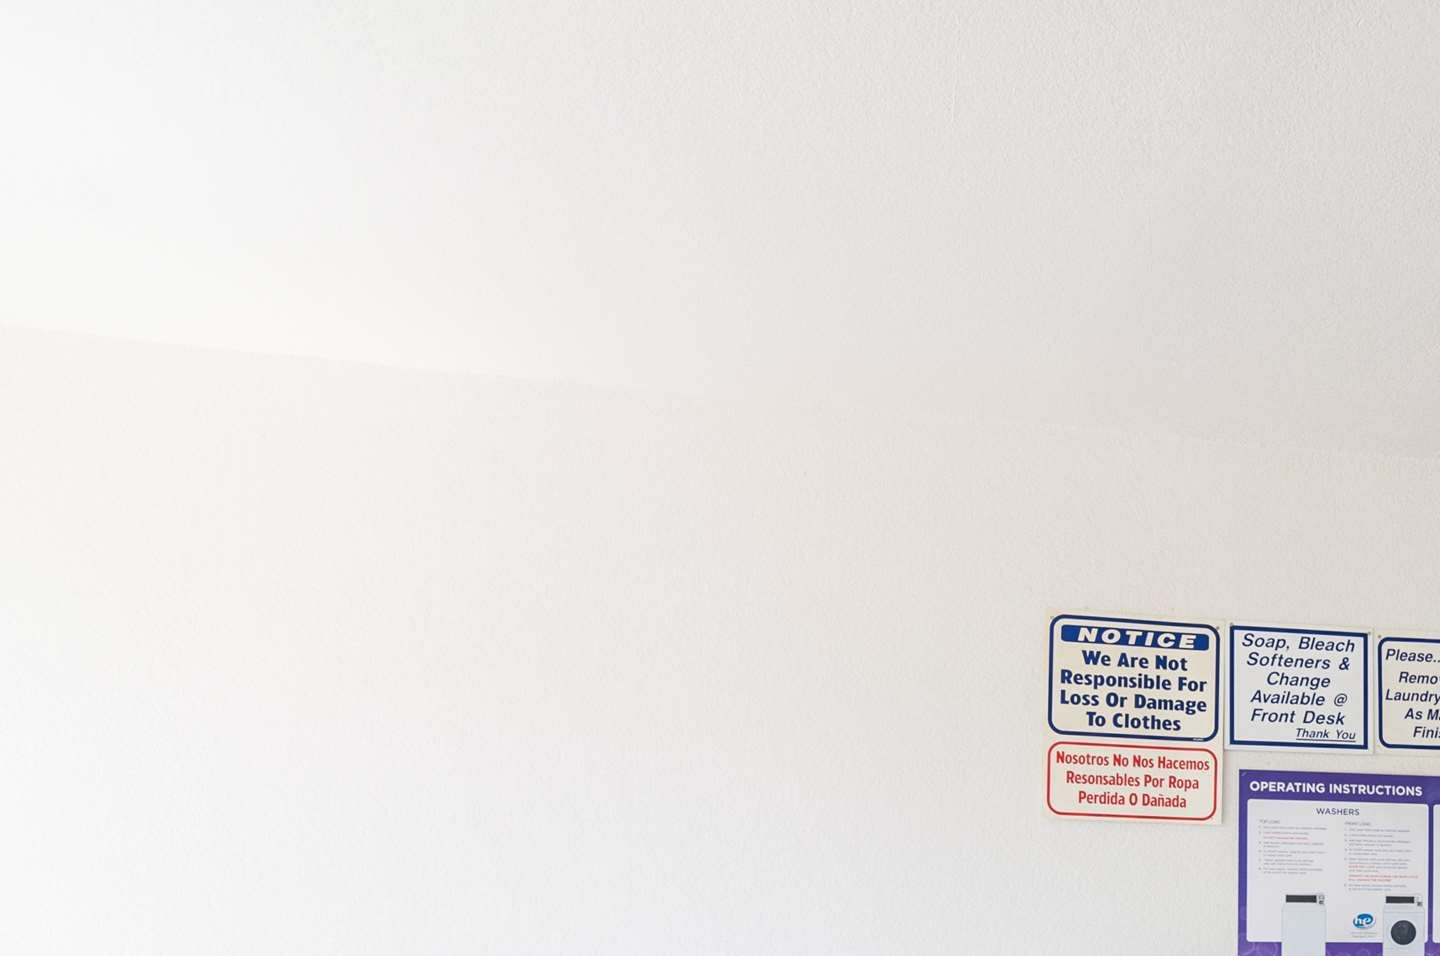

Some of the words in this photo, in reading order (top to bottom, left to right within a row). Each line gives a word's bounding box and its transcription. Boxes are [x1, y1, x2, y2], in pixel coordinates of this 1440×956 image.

[1076, 627, 1197, 649] NOTICE
[1241, 634, 1291, 652] Soap,
[1298, 636, 1355, 653] Bleach
[1083, 651, 1111, 667] We
[1118, 652, 1150, 669] Are
[1156, 655, 1187, 671] Not
[1247, 652, 1330, 670] Softeners
[1339, 657, 1351, 670] &
[1060, 670, 1172, 692] Responsible
[1178, 677, 1207, 692] For
[1267, 672, 1330, 691] Change
[1060, 691, 1100, 707] Loss
[1105, 693, 1128, 709] Or
[1134, 694, 1207, 714] Damage
[1251, 690, 1325, 706] Available
[1334, 693, 1347, 707] @
[1087, 712, 1107, 728] To
[1112, 712, 1181, 731] Clothes
[1251, 708, 1297, 725] Front
[1303, 711, 1344, 726] Desk
[1404, 708, 1423, 721] As
[1296, 728, 1329, 739] Thank
[1335, 730, 1356, 741] You
[1056, 752, 1110, 768] Nosotros
[1113, 754, 1129, 768] No
[1132, 755, 1155, 769] Nos
[1158, 756, 1210, 771] Hacemos
[1066, 771, 1141, 787] Resonsables
[1144, 774, 1165, 788] Por
[1169, 775, 1199, 791] Ropa
[1250, 781, 1326, 793] OPERATING
[1330, 783, 1422, 796] INSTRUCTIONS
[1078, 790, 1126, 806] Perdida
[1129, 792, 1138, 806] O
[1141, 792, 1186, 808] Dañada
[1316, 808, 1360, 816] WASHERS
